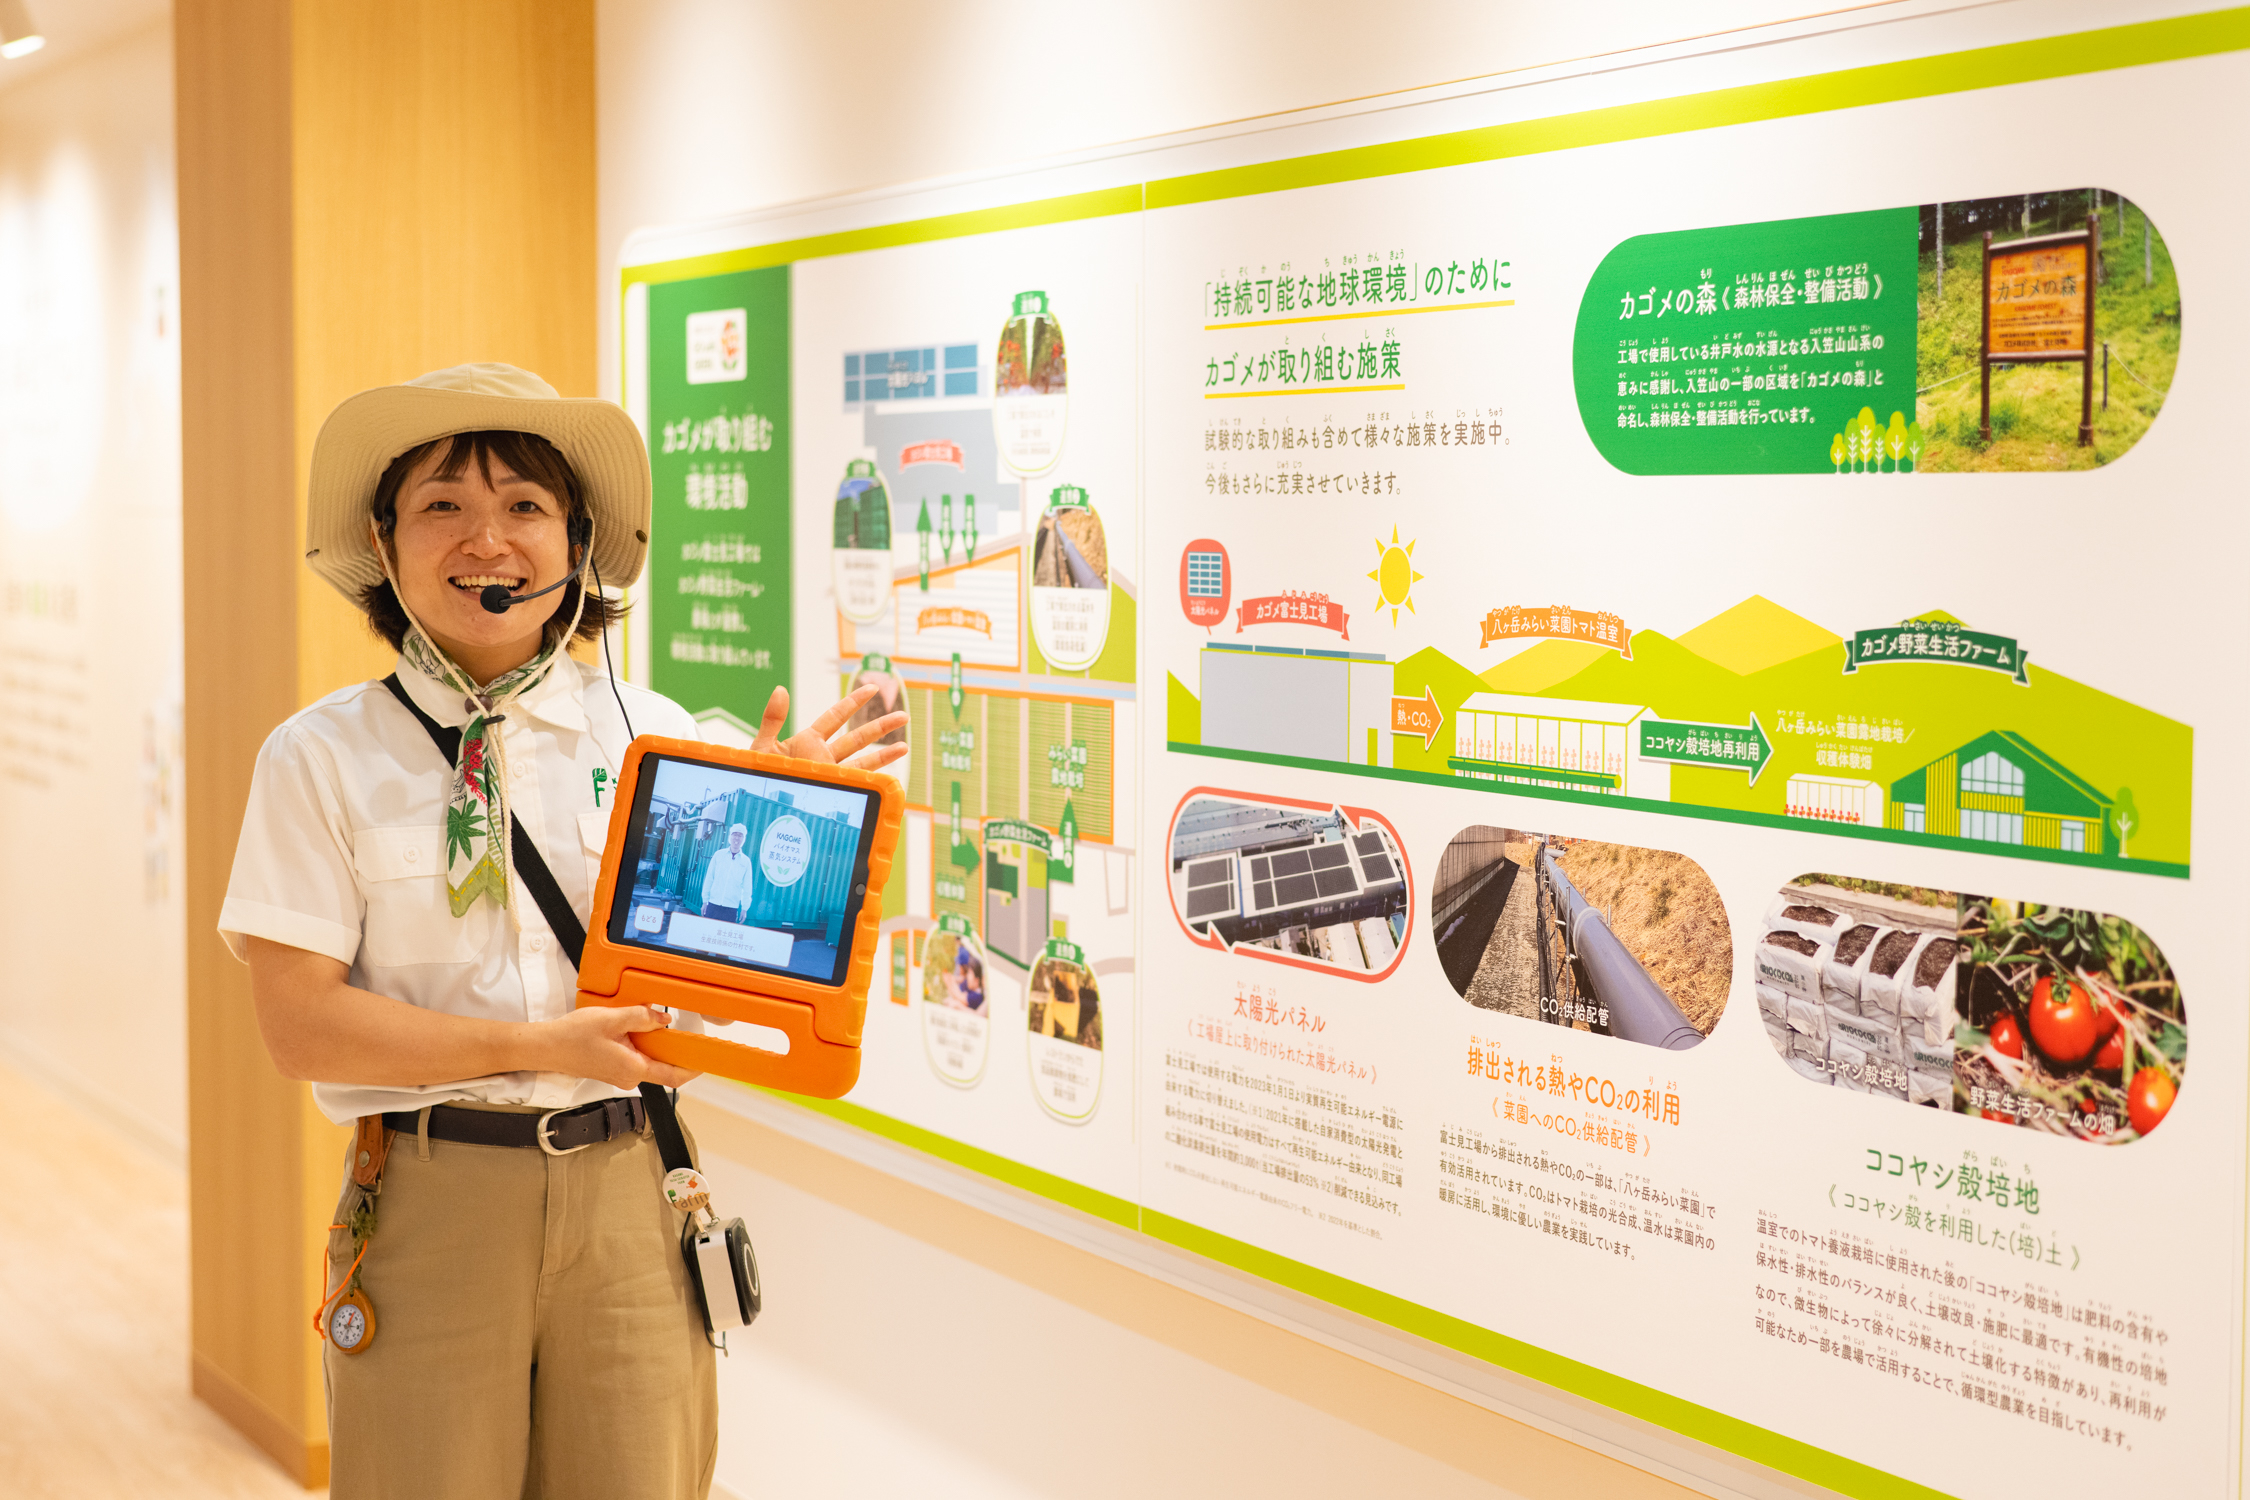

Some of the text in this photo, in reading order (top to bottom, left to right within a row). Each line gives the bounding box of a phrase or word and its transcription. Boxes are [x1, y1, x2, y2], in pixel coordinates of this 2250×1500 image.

[1205, 258, 1512, 318] 「持続可能な地球環境」のために
[1996, 275, 2077, 303] カゴメの森
[1205, 339, 1401, 387] カゴメが取り組む施策
[1618, 334, 1884, 364] 工場で使用している井戸水の水源となる入笠山山系の
[1618, 369, 1884, 396] 恵みに感謝し、入笠山の一部の区域を「カゴメの森」と
[1617, 407, 1815, 429] 命名し、森林保全・整備活動を行っています。
[1205, 420, 1511, 452] 試験的な取り組みも含めて様々な施策を実施中。
[1205, 471, 1401, 495] 今後もさらに充実させていきます。
[1256, 601, 1328, 623] カゴメ富士見工場
[1492, 615, 1618, 643] 八ヶ岳みらい菜園トマト温室
[1861, 633, 2011, 665] カゴメ野菜生活ファーム
[1646, 736, 1760, 761] ココヤシ殻培地再利用
[1816, 749, 1872, 770] 収穫体験畑
[773, 843, 801, 855] バイオマス
[776, 832, 802, 845] KAGOME
[768, 851, 801, 865] 蒸気システム
[641, 914, 657, 924] もどる
[1234, 991, 1326, 1033] 太陽光パネル
[1816, 1057, 1908, 1091] ココヤシ殻培地
[1970, 1086, 2114, 1135] 野菜生活ファームの畑
[1866, 1149, 2040, 1215] ココヤシ殻培地
[1439, 1187, 1635, 1260] 暖房に活用し、環境に優しい農業を実践しています。
[1757, 1216, 2168, 1346] 温室でのトマト養液栽培に使用された後の「ココヤシ殻培地」は肥料の含有や
[1756, 1250, 2168, 1387] 保水性・排水性のバランスが良く、土壌改良・施肥に最適です。有機性の培地
[1755, 1284, 2167, 1422] なので、微生物によって徐々に分解されて土壌化する特徴があり、再利用が
[1754, 1316, 2132, 1452] 可能なため一部を農場で活用することで、循環型農業を目指しています。
